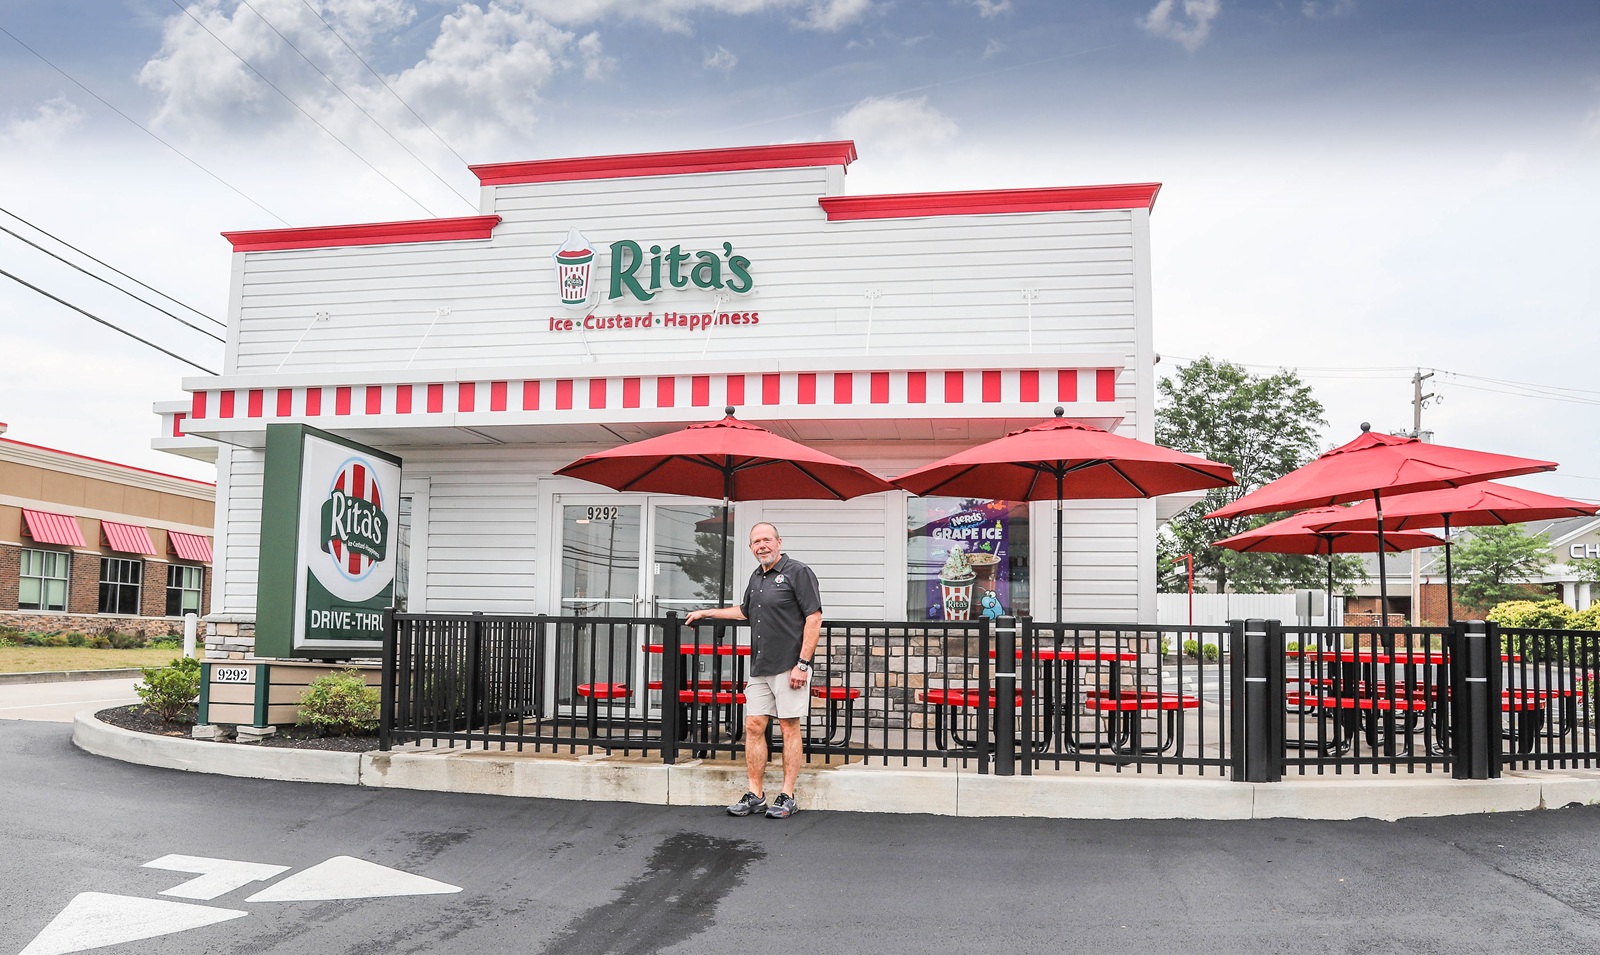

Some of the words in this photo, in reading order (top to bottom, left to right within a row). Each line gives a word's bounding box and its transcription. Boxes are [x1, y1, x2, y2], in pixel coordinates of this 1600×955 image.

[608, 239, 755, 301] Rita's
[549, 317, 573, 331] Ice
[583, 311, 653, 330] Custard
[664, 309, 760, 331] Happiness
[331, 491, 382, 545] Rita's
[587, 506, 618, 520] 9292
[932, 527, 979, 540] GRAPE
[981, 527, 1003, 540] ICE
[218, 668, 248, 681] 9292
